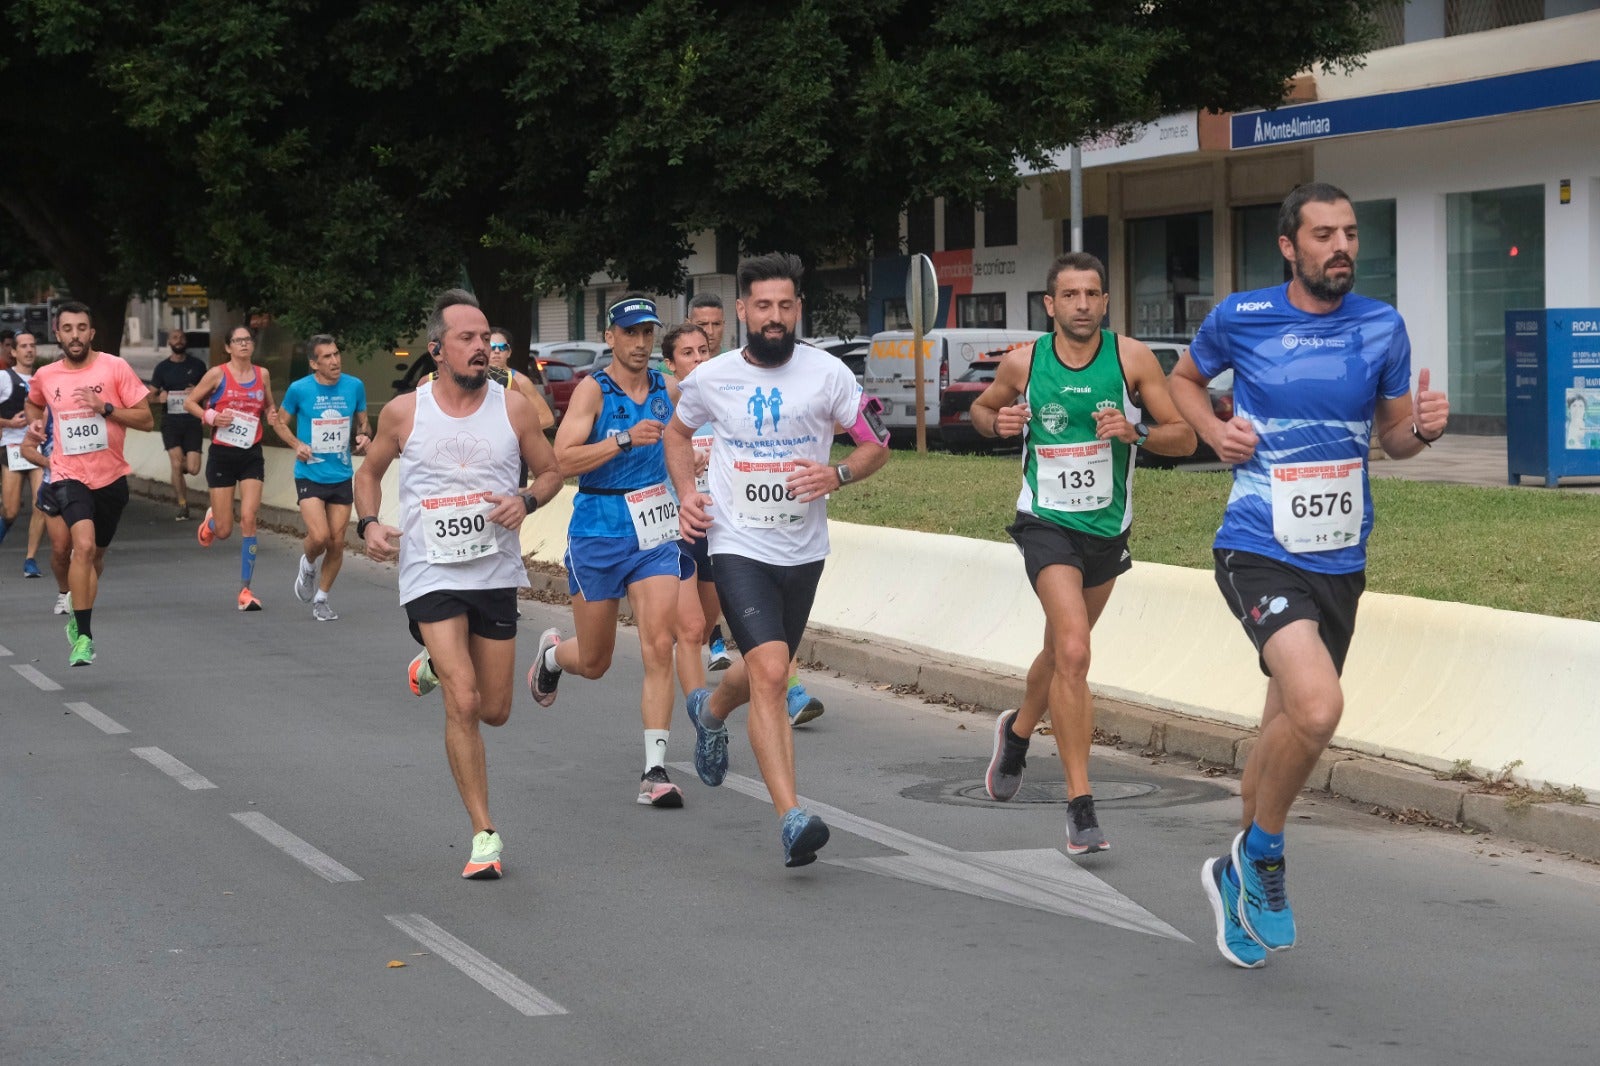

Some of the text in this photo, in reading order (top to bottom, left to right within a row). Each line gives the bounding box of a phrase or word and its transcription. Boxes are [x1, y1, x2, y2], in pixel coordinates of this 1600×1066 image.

[1160, 125, 1189, 140] zome.es
[1264, 115, 1331, 140] MonteAlminara
[974, 263, 982, 275] de
[983, 258, 1016, 275] confianza
[1236, 301, 1274, 312] HOKA
[1572, 321, 1598, 332] ROPA
[1300, 334, 1324, 349] edp
[66, 423, 99, 438] 3480
[228, 423, 248, 437] 252
[322, 431, 341, 441] 241
[745, 440, 781, 448] CARRERA
[1057, 469, 1096, 489] 133
[1274, 467, 1298, 482] 42
[1298, 465, 1335, 474] CARRERA
[1291, 491, 1352, 518] 6576
[638, 501, 676, 527] 11702
[434, 514, 485, 538] 3590
